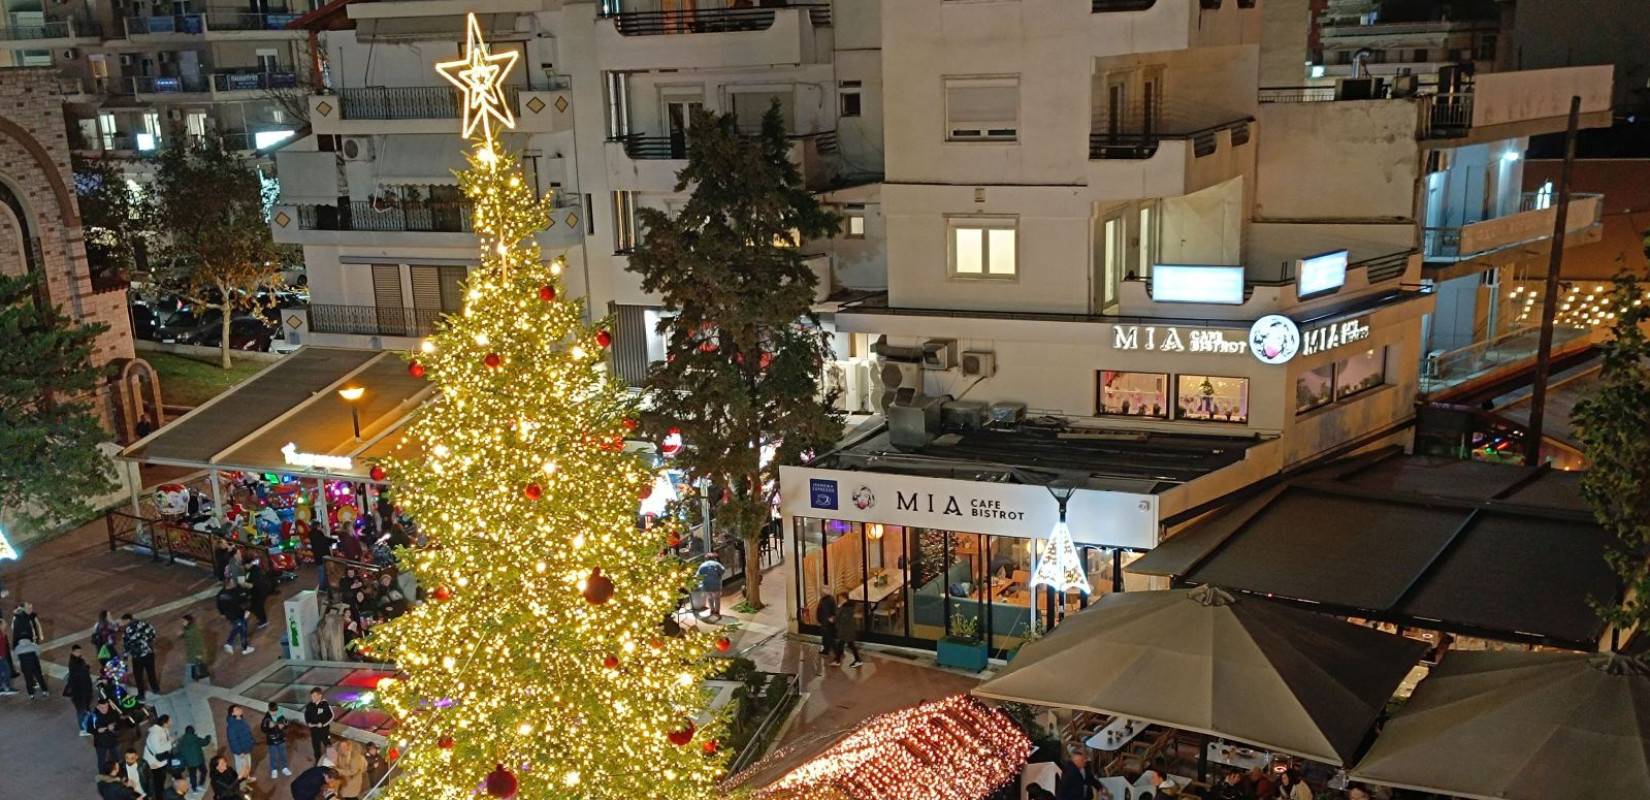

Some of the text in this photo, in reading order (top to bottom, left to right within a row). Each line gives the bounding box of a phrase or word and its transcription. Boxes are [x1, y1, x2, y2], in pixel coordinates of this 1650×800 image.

[1113, 325, 1185, 352] MIA
[1189, 340, 1247, 353] BISTROT
[896, 490, 963, 516] MIA
[970, 499, 1001, 510] CAFE
[971, 508, 1025, 521] BISTROT
